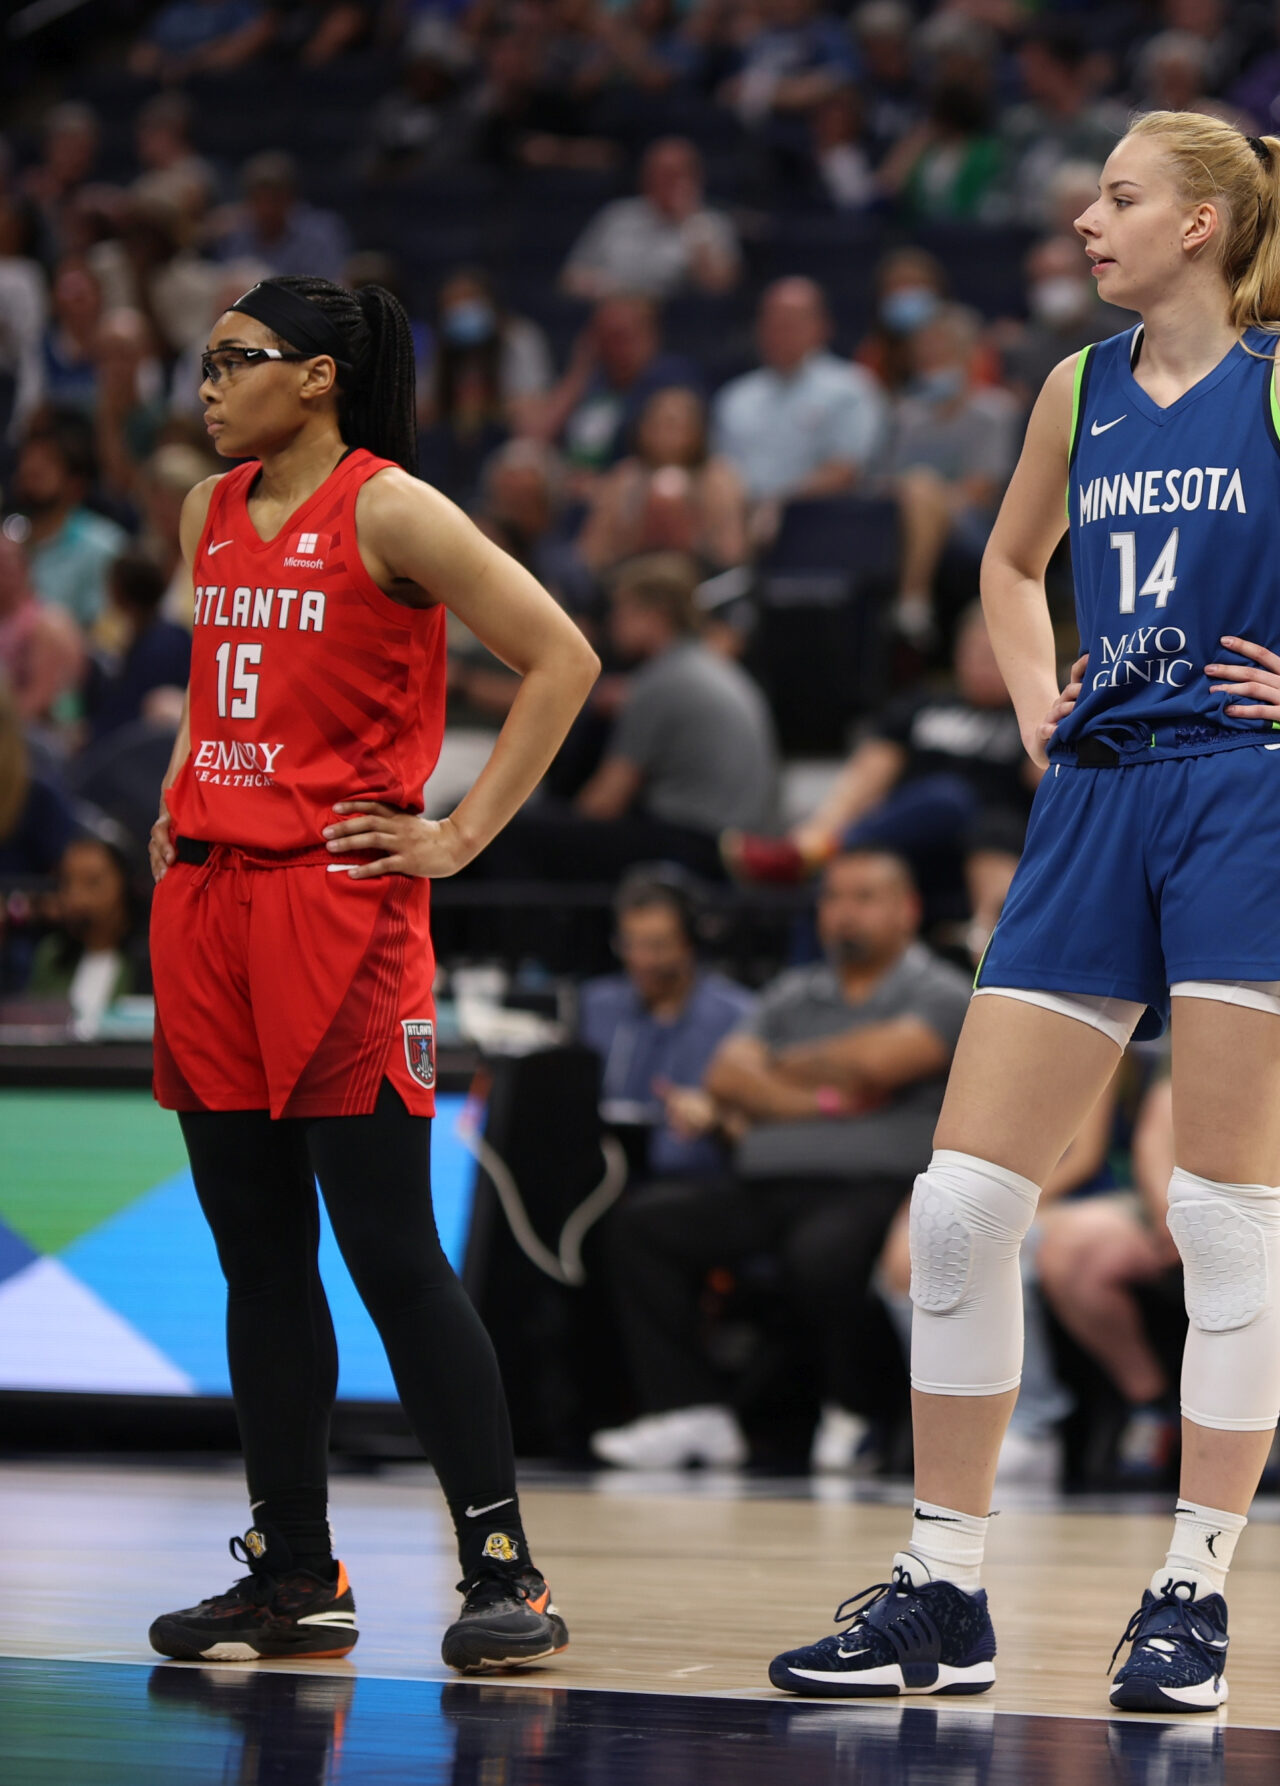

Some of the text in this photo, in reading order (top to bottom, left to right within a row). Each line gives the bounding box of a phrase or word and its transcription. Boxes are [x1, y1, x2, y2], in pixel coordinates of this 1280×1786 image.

[1079, 467, 1247, 528] MINNESOTA
[283, 556, 324, 570] Microsoft
[1109, 526, 1180, 615] 14
[193, 585, 326, 632] ATLANTA
[215, 641, 263, 719] 15
